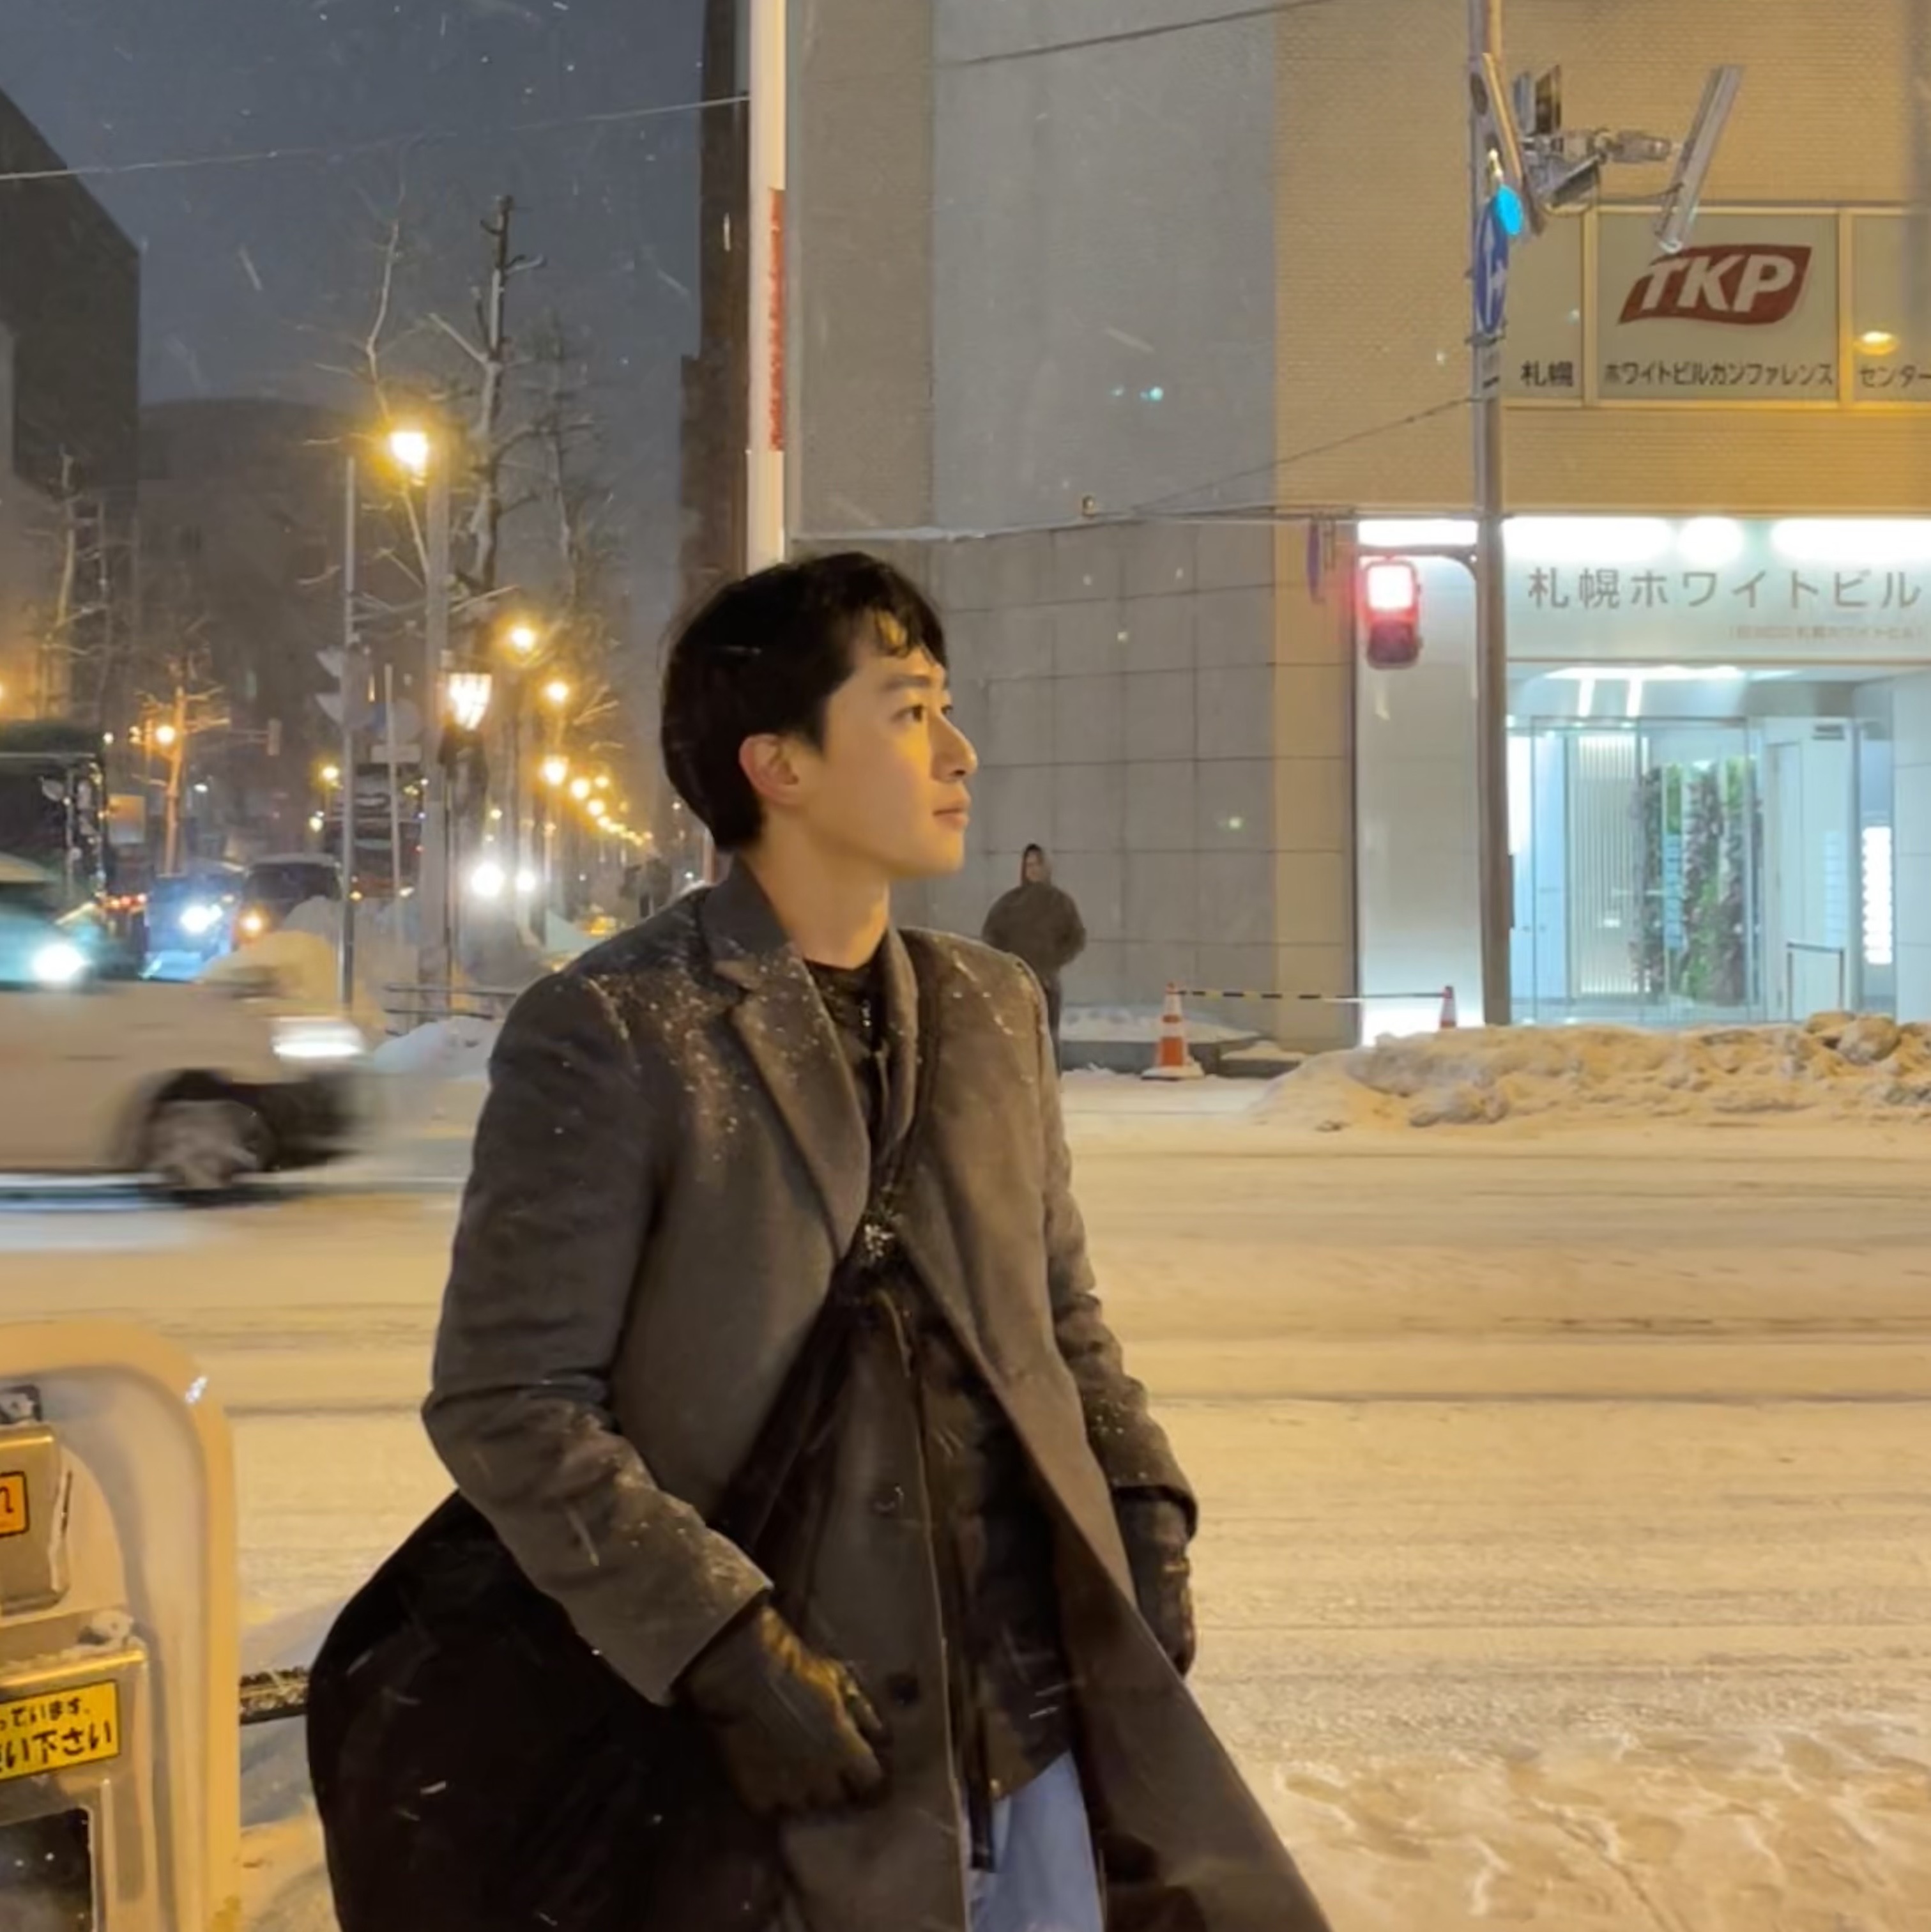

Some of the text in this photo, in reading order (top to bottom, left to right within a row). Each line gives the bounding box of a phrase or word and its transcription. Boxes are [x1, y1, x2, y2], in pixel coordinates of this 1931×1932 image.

[1639, 254, 1796, 313] TKP
[1604, 361, 1833, 385] ホワイトビルカンファレンス
[1859, 364, 1931, 388] センター
[1527, 568, 1922, 609] 札幌ホワイトビル
[0, 1721, 111, 1773] い下さい
